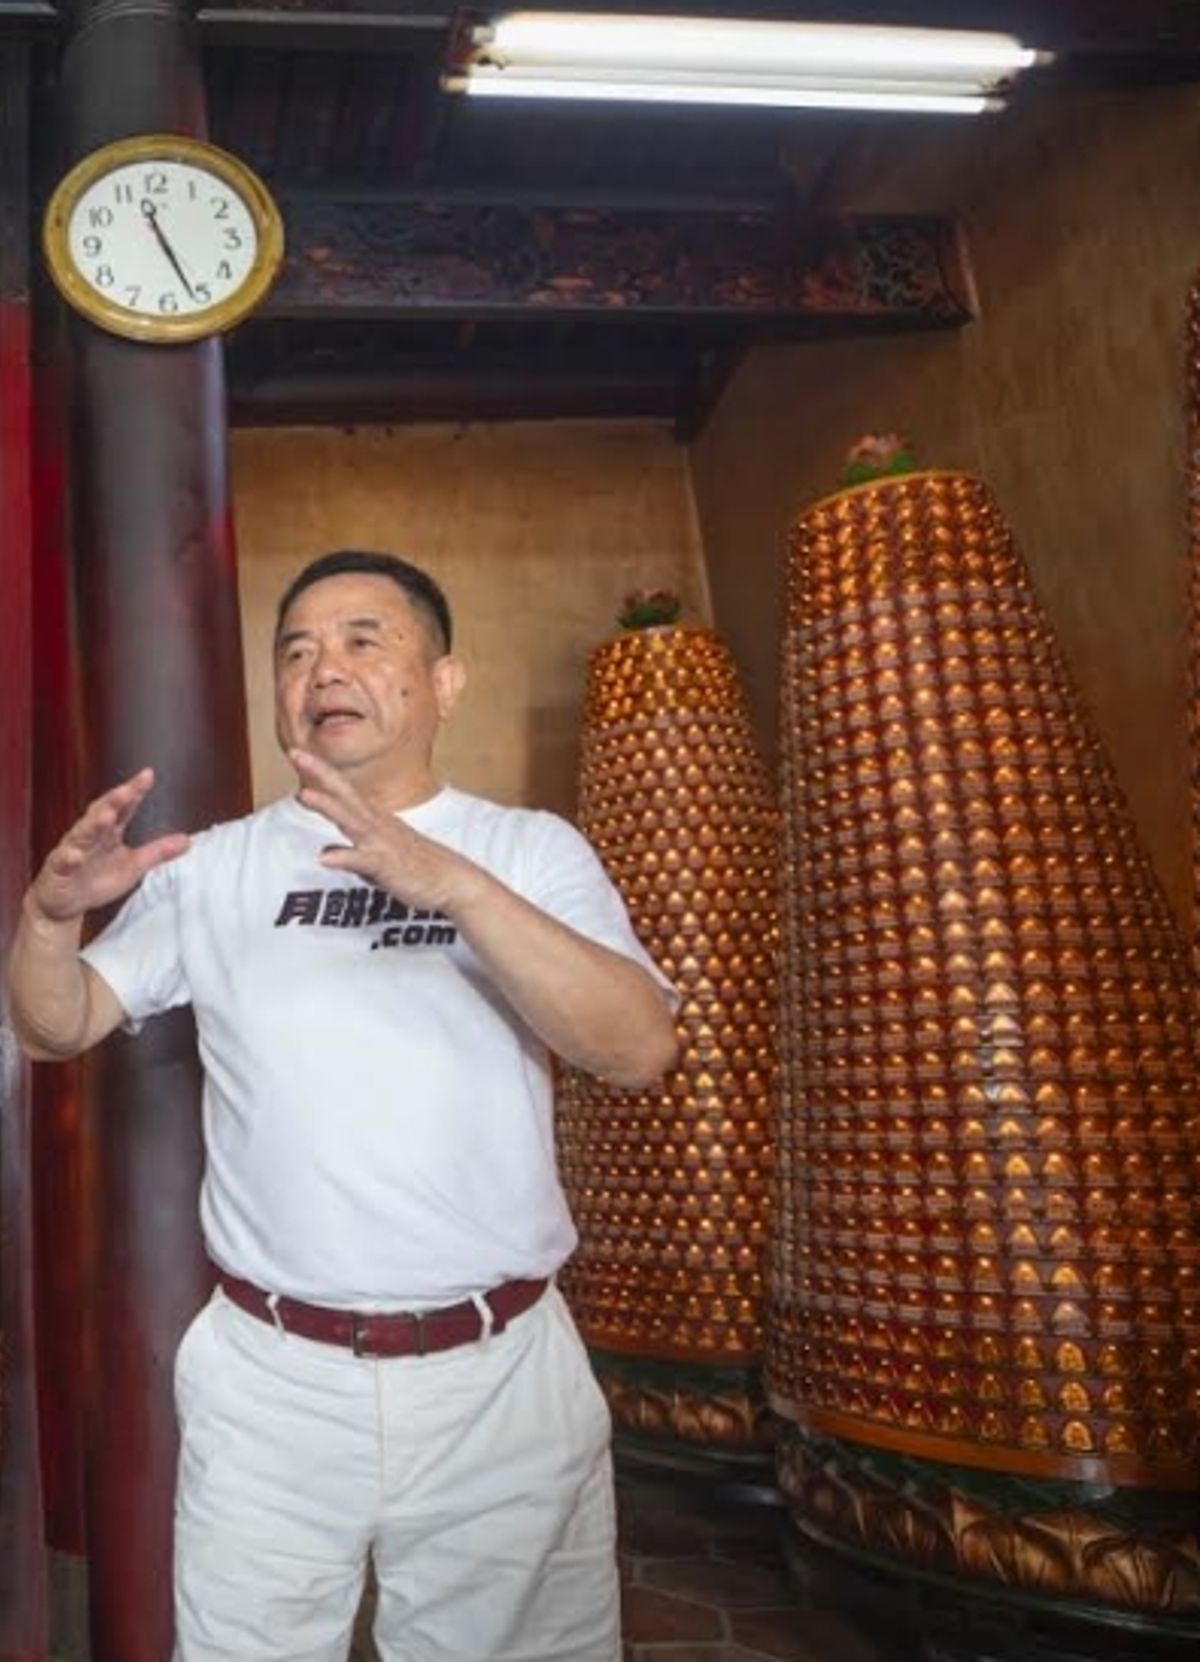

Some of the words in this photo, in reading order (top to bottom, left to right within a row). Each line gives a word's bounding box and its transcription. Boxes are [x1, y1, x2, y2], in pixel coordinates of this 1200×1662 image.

[115, 184, 133, 203] 11
[144, 172, 168, 194] 12
[188, 179, 197, 201] 1
[88, 206, 113, 228] 10
[211, 197, 230, 219] 2
[82, 235, 103, 257] 9
[223, 227, 242, 250] 3
[95, 264, 115, 287] 8
[217, 260, 233, 280] 4
[125, 286, 141, 306] 7
[158, 292, 179, 314] 6
[194, 282, 212, 304] 5
[371, 924, 457, 950] .com
